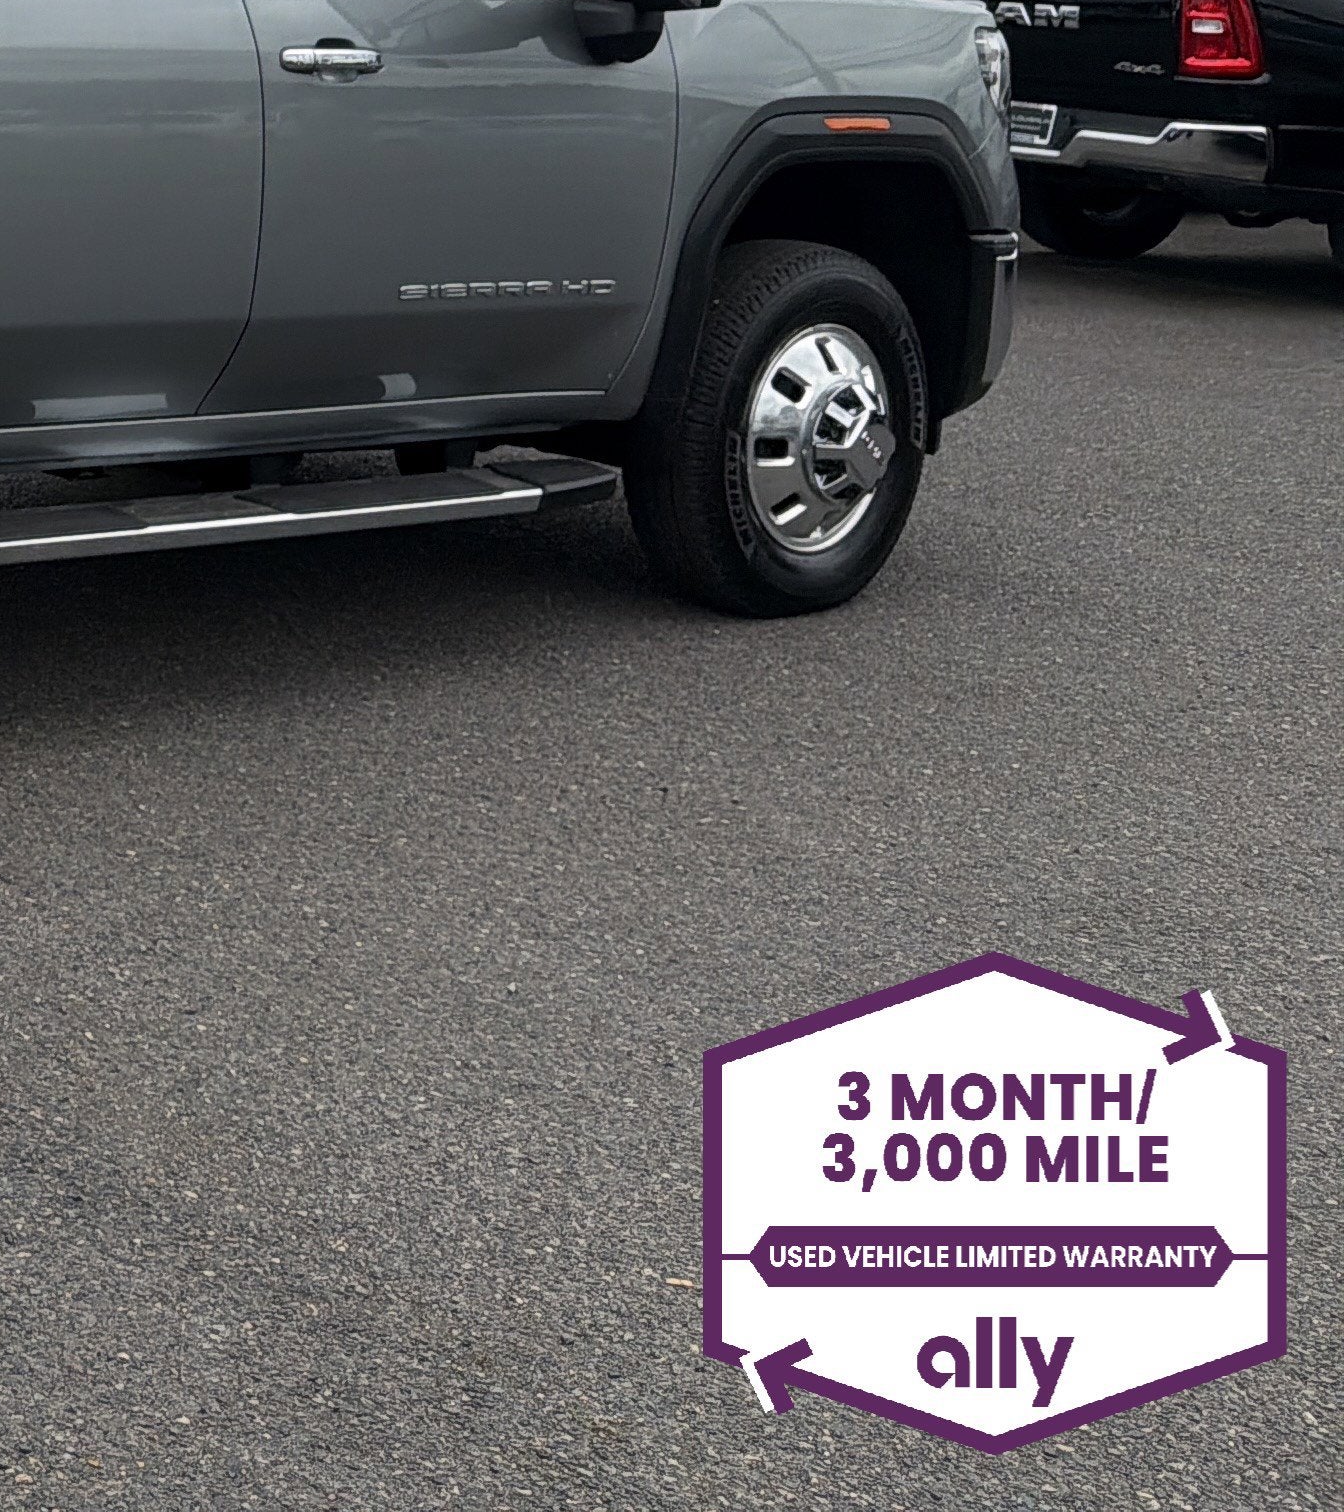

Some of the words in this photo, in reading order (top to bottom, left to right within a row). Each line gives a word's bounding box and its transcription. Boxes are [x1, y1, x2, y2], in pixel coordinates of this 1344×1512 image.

[995, 1, 1081, 29] AM
[399, 281, 553, 301] SIERRA
[561, 279, 617, 297] HD
